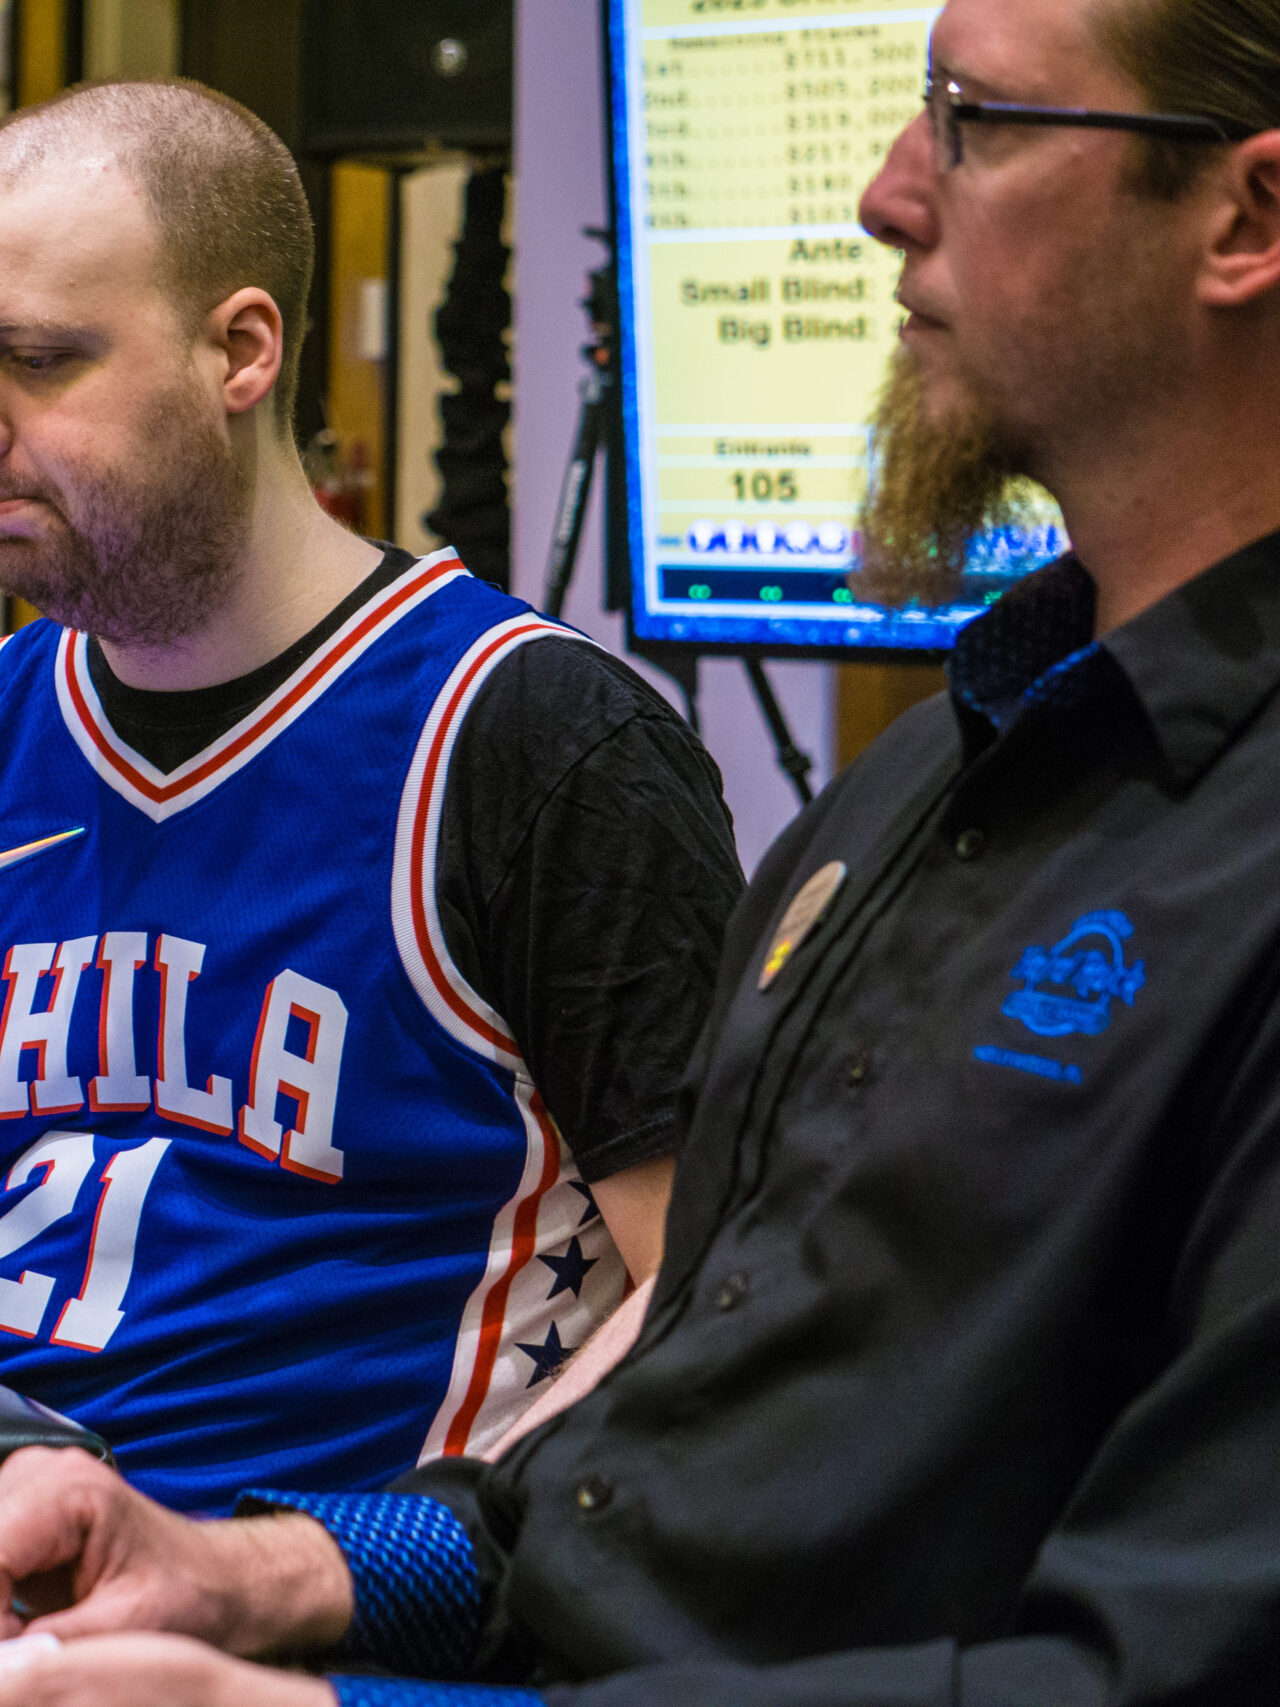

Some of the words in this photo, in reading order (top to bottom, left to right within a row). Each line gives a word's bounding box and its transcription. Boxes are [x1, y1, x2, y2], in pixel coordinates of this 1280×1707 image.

[680, 278, 769, 306] Small
[718, 314, 771, 350] Big
[731, 469, 800, 504] 105
